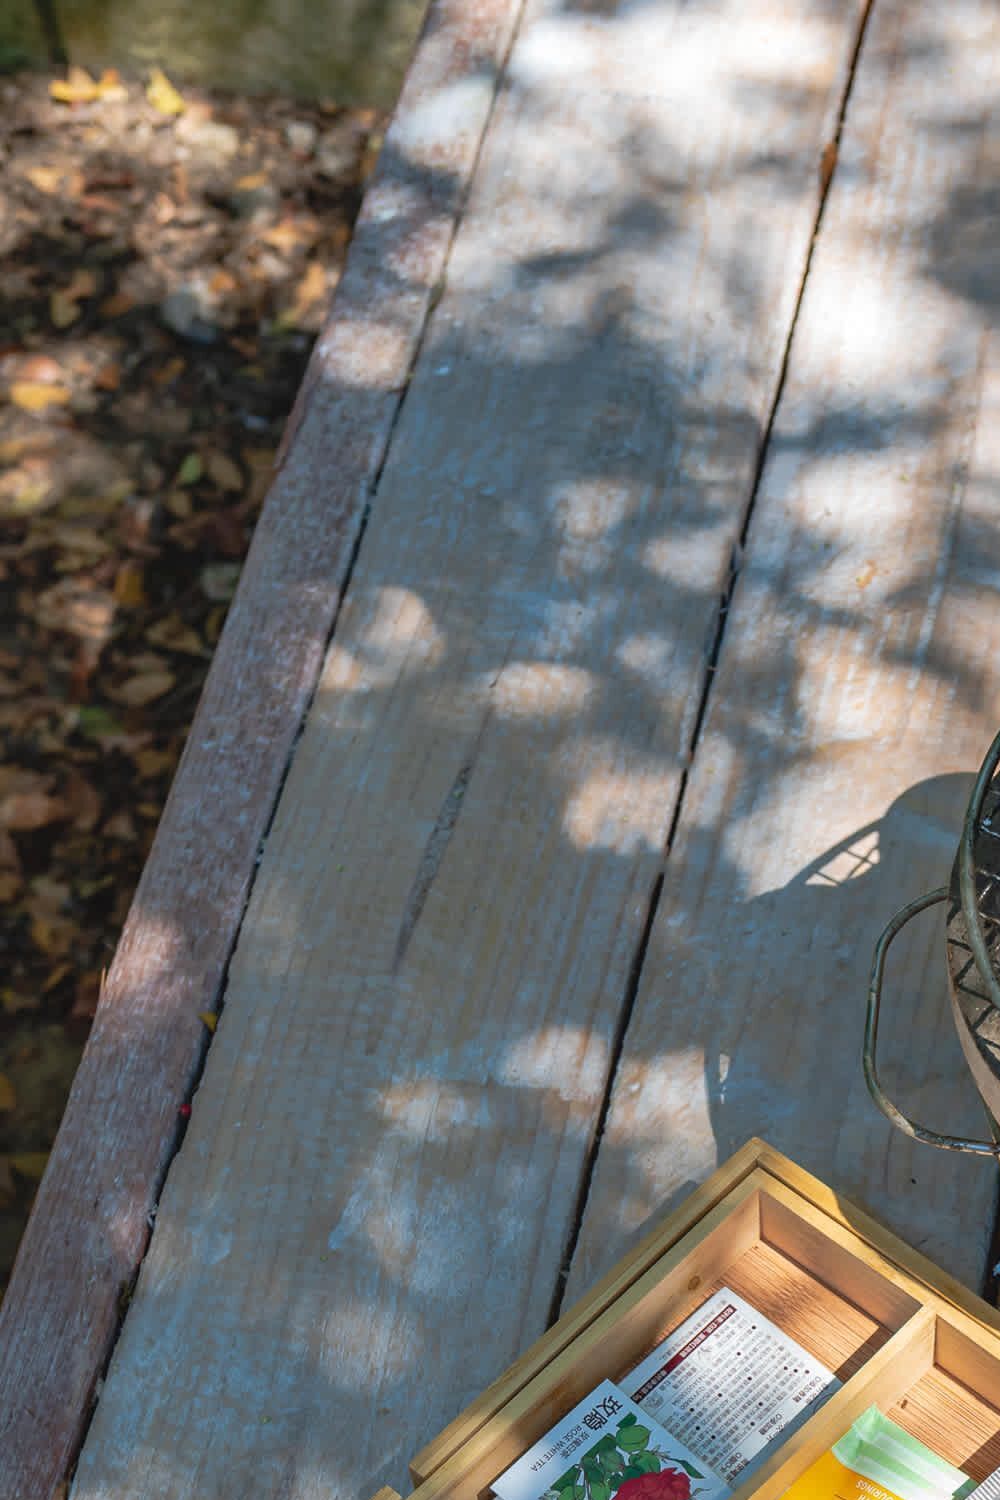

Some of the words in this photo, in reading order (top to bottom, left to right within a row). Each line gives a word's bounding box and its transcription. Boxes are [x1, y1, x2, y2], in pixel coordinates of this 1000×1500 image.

[579, 1393, 624, 1434] 玫隐
[562, 1423, 582, 1442] ROSE
[541, 1438, 566, 1461] WHITE
[529, 1458, 544, 1473] TEA
